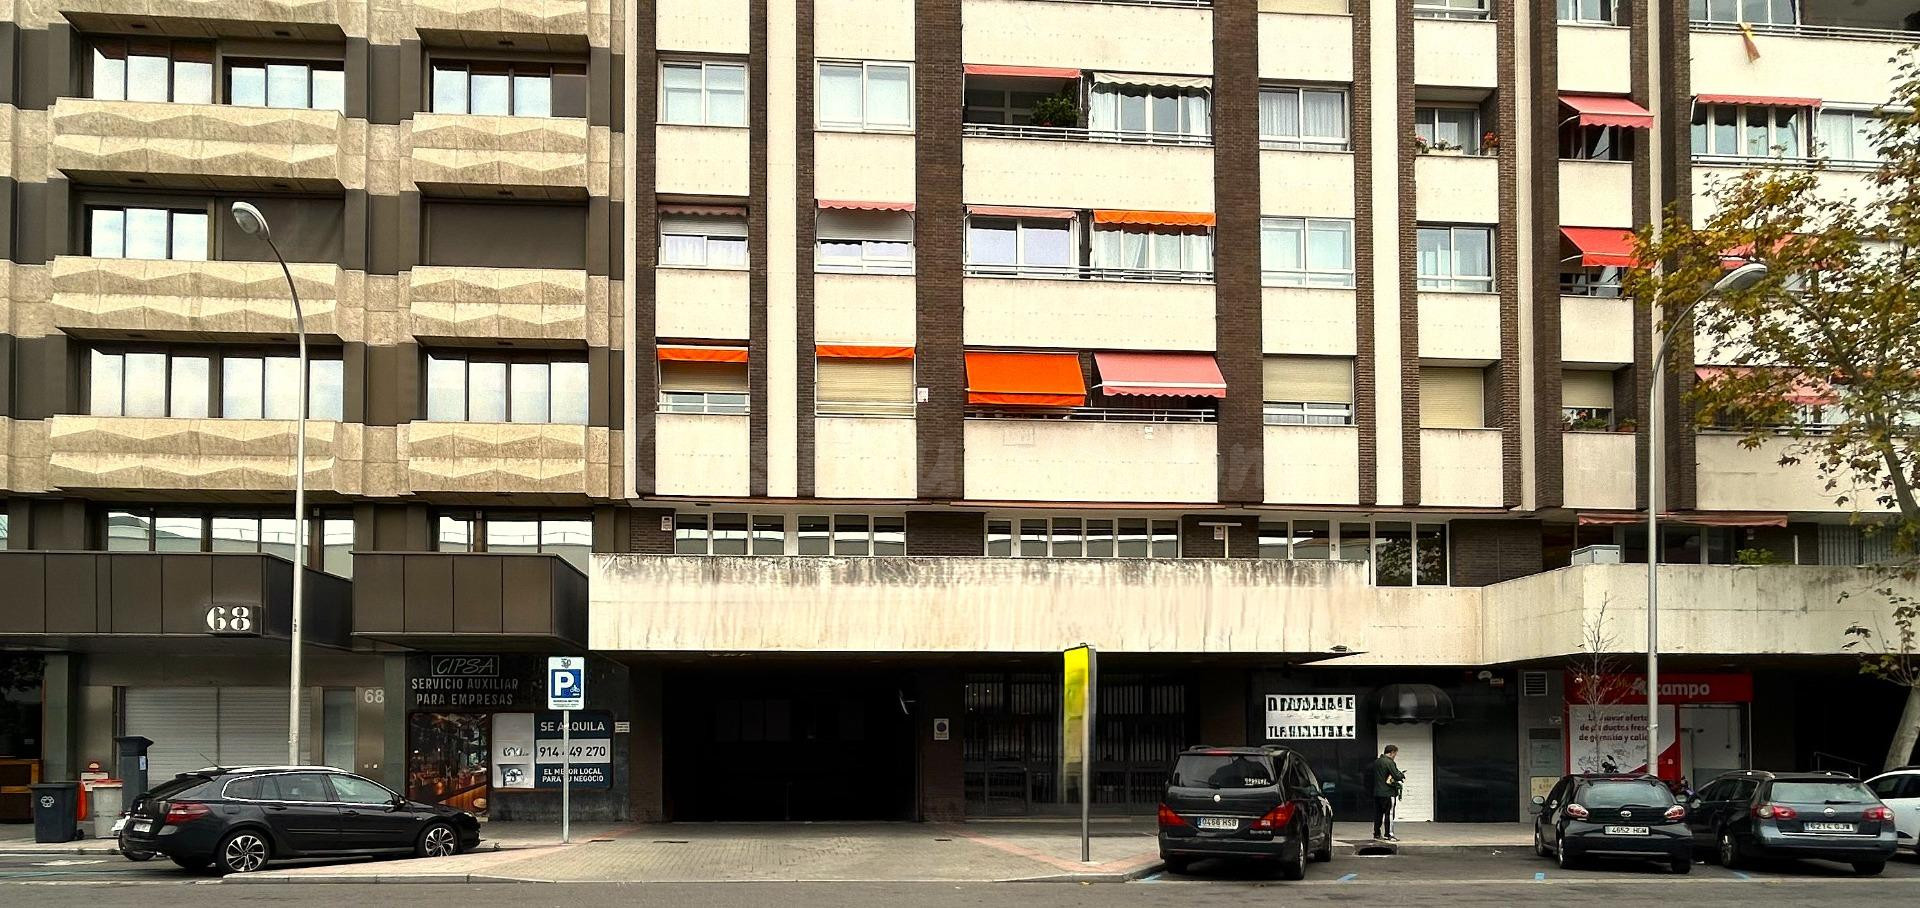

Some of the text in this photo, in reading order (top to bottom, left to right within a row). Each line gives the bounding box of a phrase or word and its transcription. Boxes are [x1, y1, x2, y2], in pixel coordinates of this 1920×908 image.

[206, 606, 251, 631] 68
[437, 657, 494, 675] CIPSA
[411, 678, 519, 690] SERVICIO AUXILIAR
[554, 671, 575, 697] P
[1630, 676, 1710, 699] Aampo
[364, 689, 385, 703] 68
[416, 693, 513, 705] PARA EMPRESAS
[540, 722, 555, 732] SE
[539, 746, 559, 757] 914
[561, 746, 582, 757] 49
[586, 746, 606, 757] 270
[579, 767, 602, 775] LOCAL
